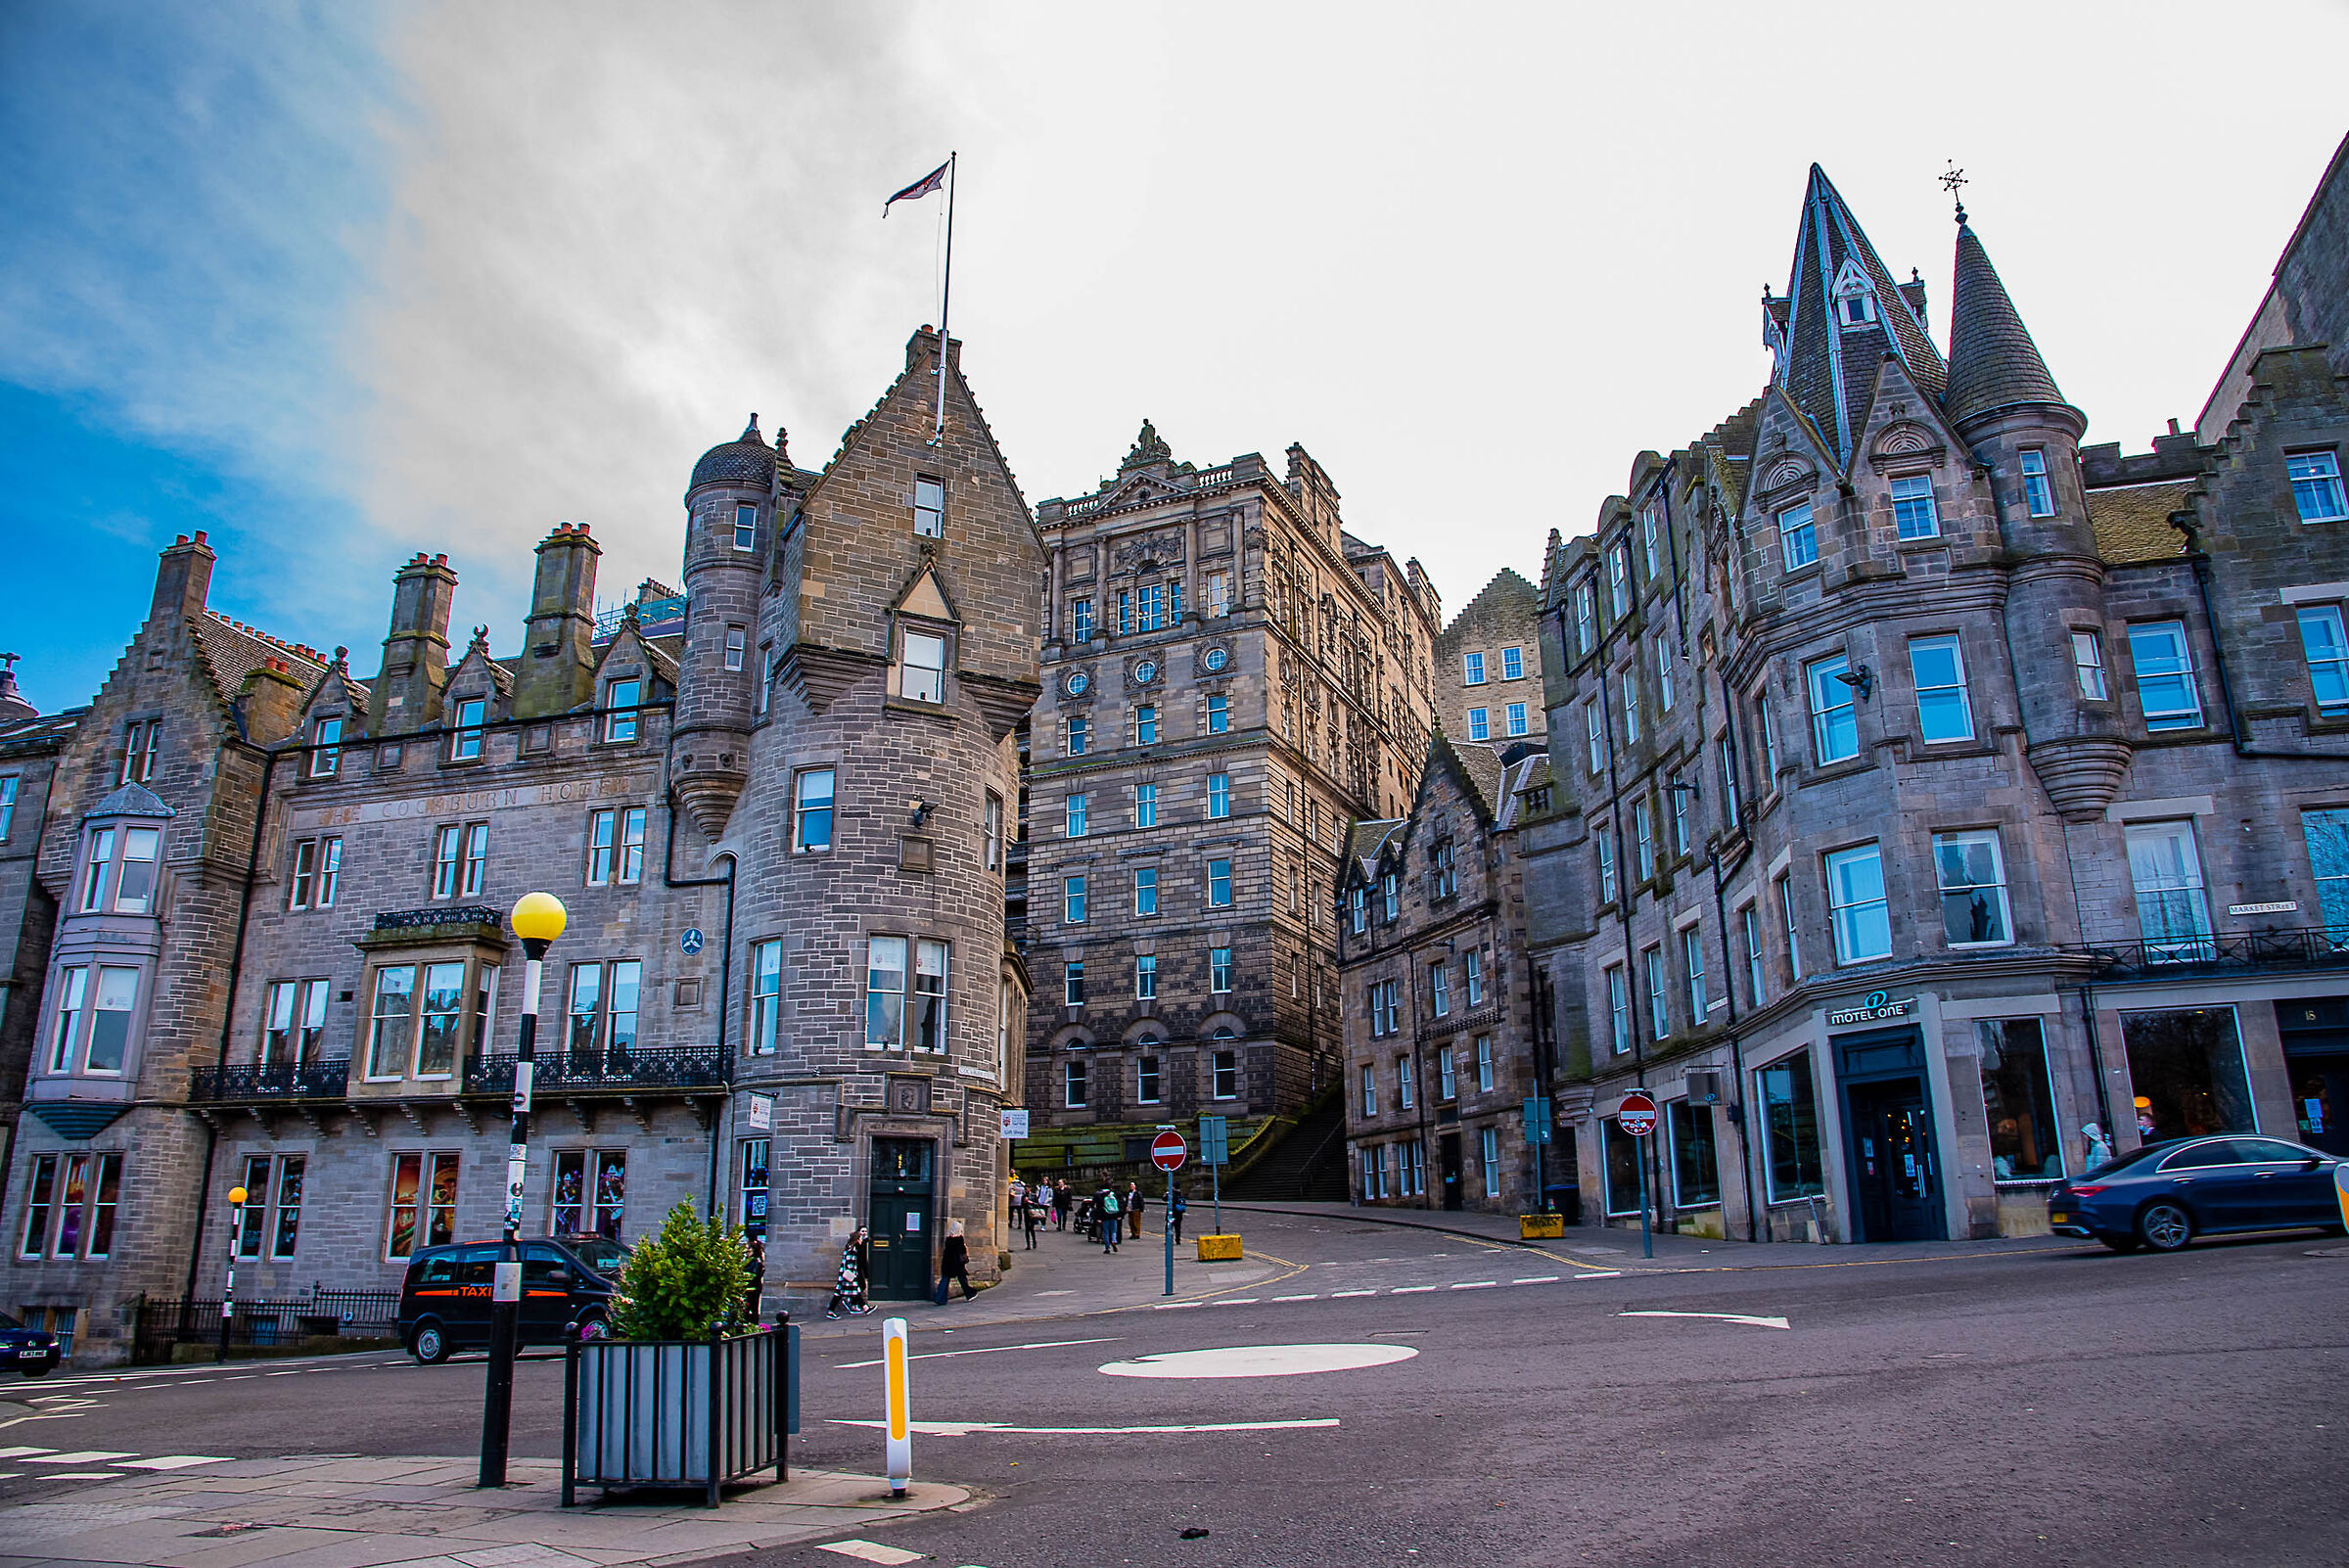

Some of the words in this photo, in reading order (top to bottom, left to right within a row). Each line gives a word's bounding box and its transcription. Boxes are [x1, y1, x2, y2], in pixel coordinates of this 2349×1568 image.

[318, 804, 361, 824] THE
[383, 789, 518, 817] COCKBURN
[540, 777, 630, 802] HOTEL
[1831, 1010, 1875, 1024] MOTEL
[1877, 1005, 1904, 1018] ONE
[460, 1286, 492, 1297] TAXI
